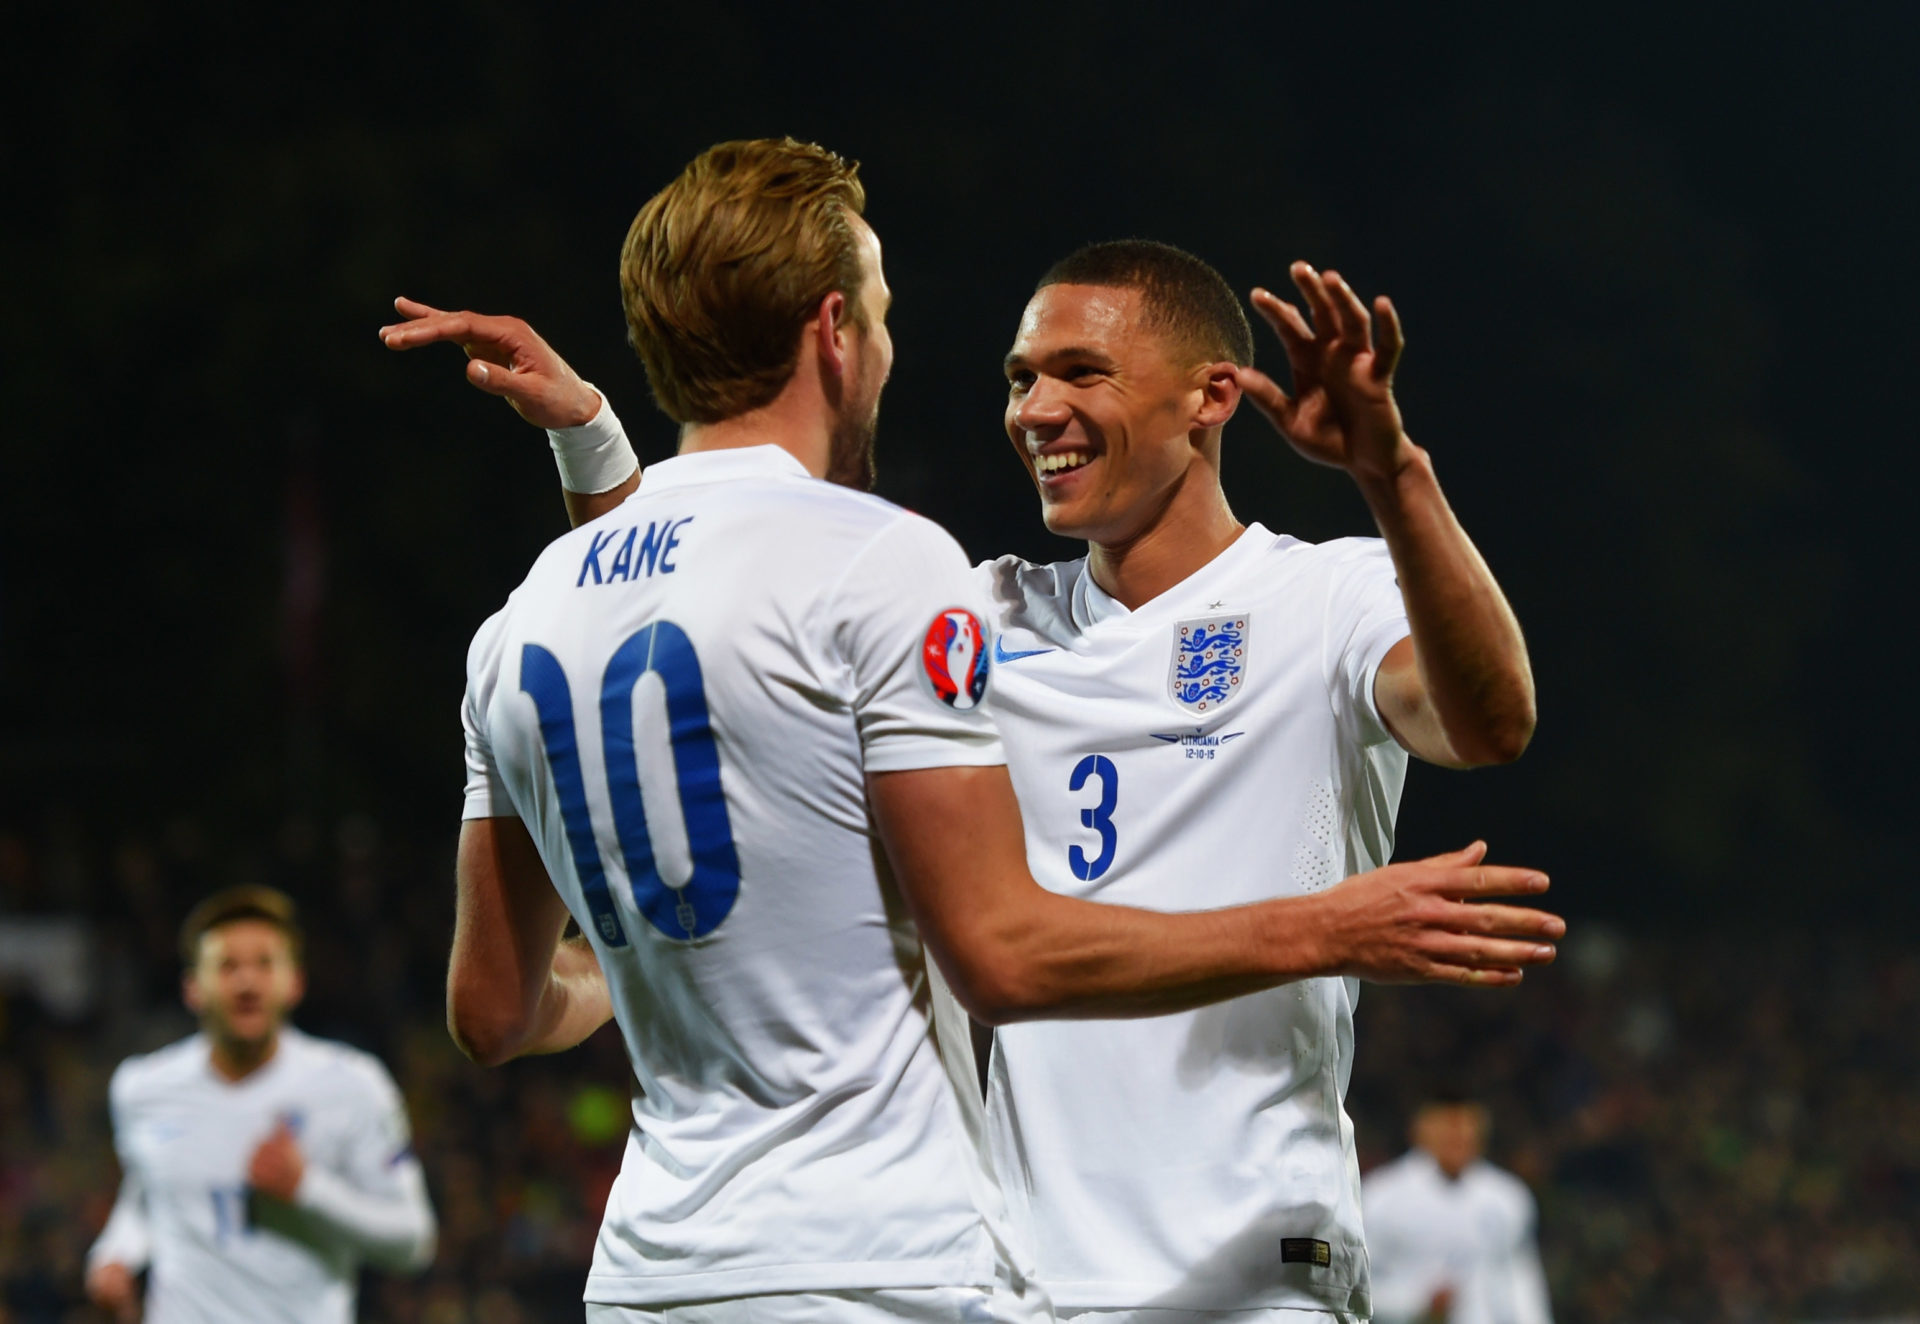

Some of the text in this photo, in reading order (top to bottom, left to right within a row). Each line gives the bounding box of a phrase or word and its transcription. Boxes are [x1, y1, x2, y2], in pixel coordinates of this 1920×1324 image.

[576, 515, 695, 588] KANE
[1180, 734, 1219, 746] LITHUANIA
[1185, 748, 1216, 760] 12-10-15
[519, 619, 742, 948] 10
[1068, 754, 1119, 882] 3
